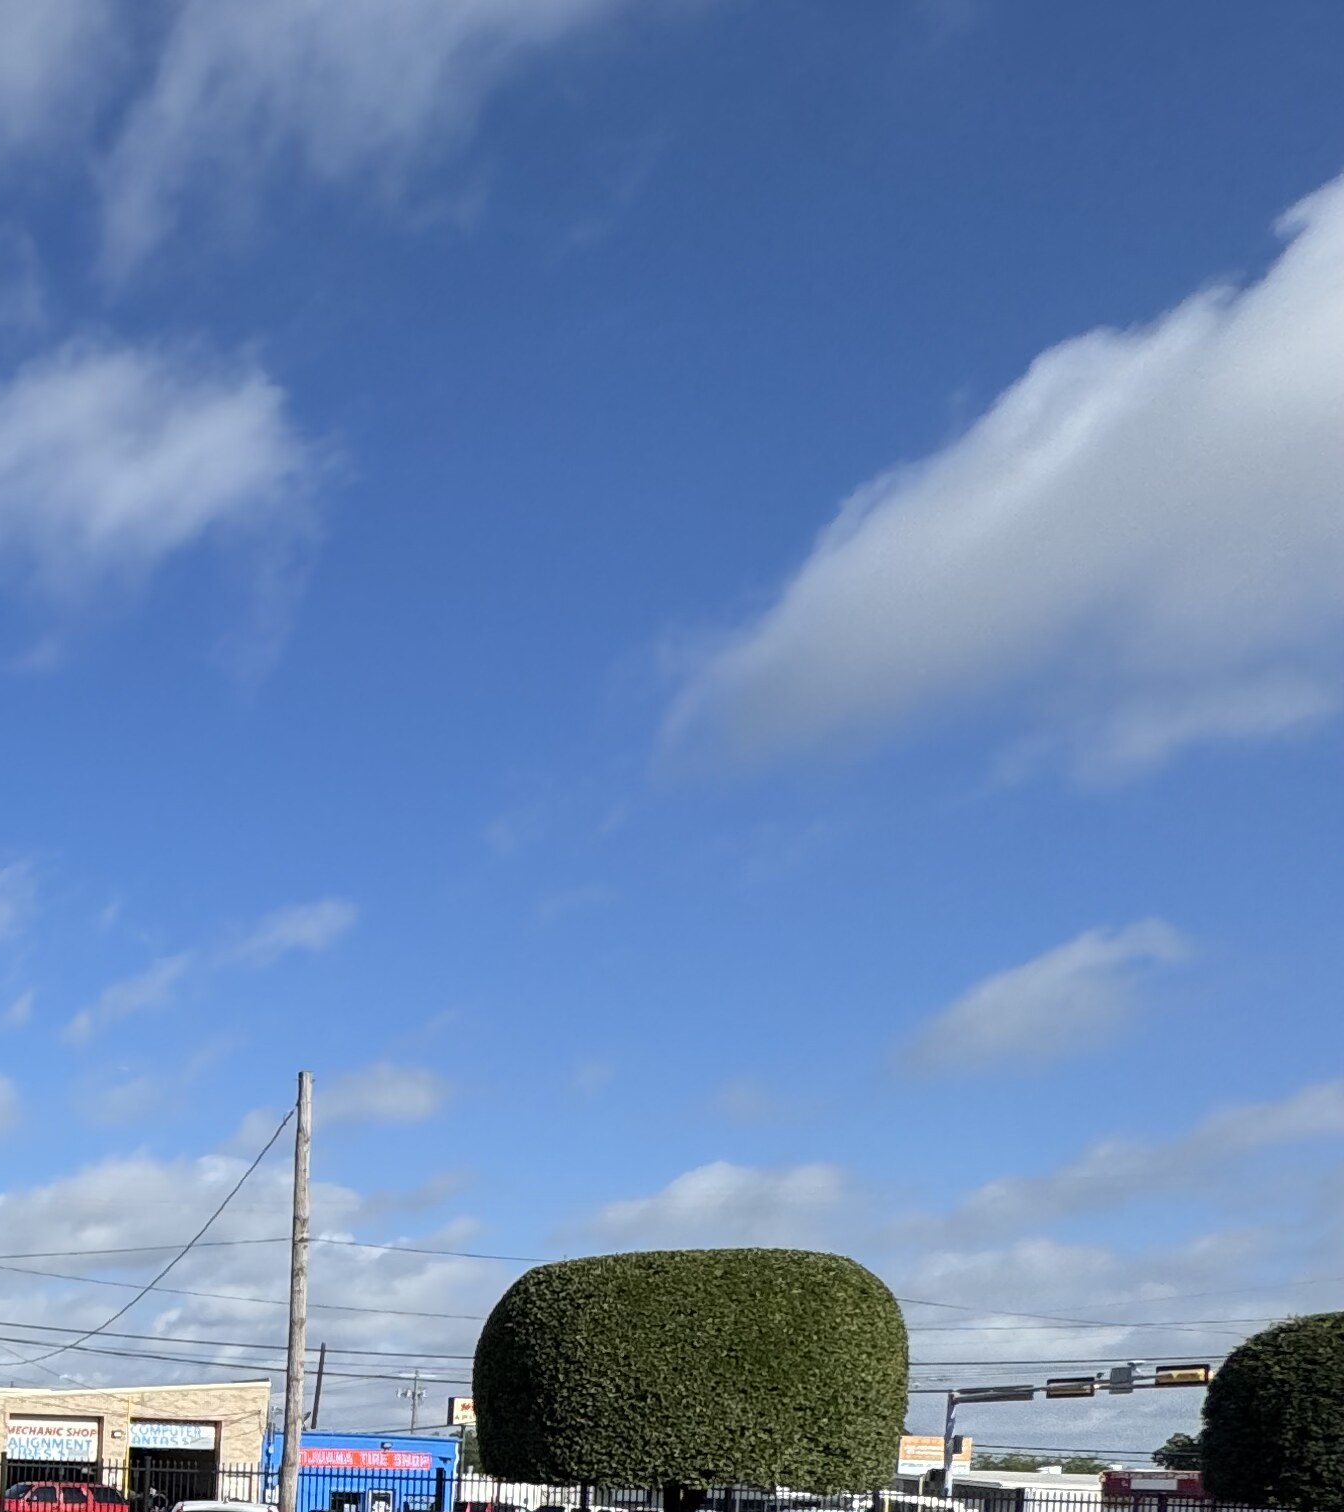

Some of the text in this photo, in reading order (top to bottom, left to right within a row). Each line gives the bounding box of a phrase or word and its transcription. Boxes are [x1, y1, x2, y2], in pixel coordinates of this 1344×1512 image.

[7, 1426, 98, 1438] MECHANIC SHOP
[8, 1437, 93, 1451] ALIGNMENT
